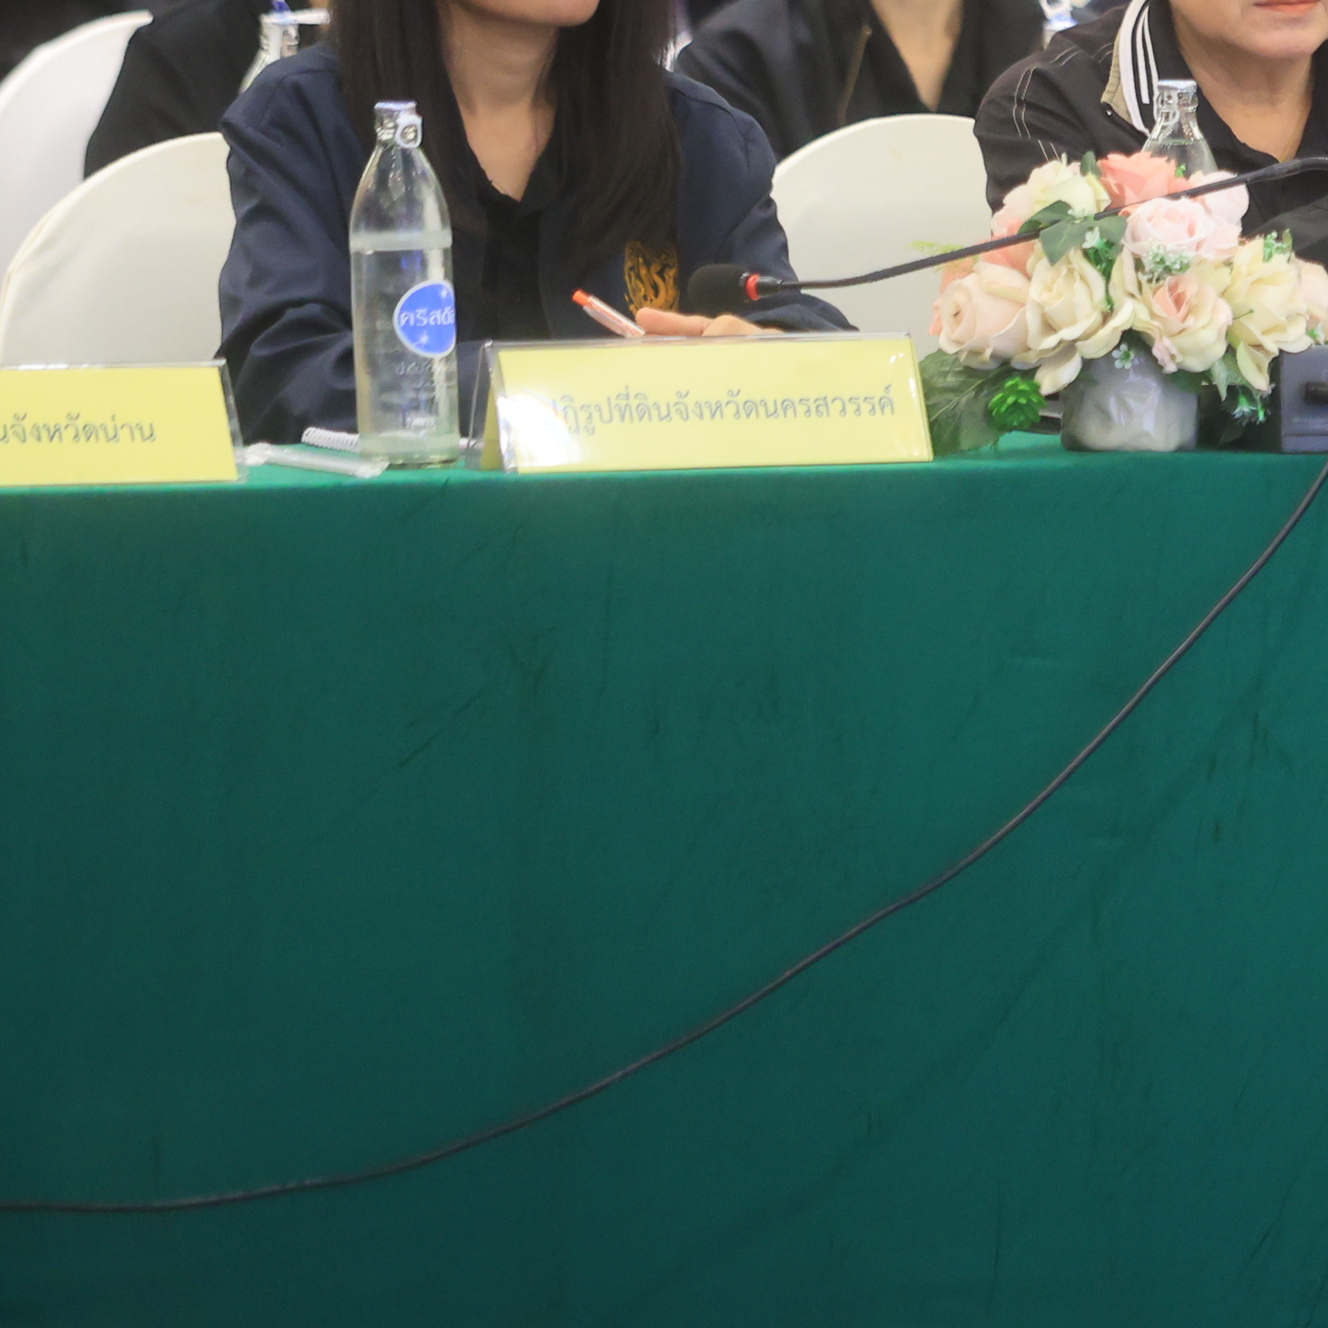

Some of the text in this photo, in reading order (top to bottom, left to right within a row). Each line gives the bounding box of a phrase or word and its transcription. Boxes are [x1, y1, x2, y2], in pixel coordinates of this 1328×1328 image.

[550, 384, 896, 436] ฏิรูปที่ดินจังหวัดนครสวรรค์
